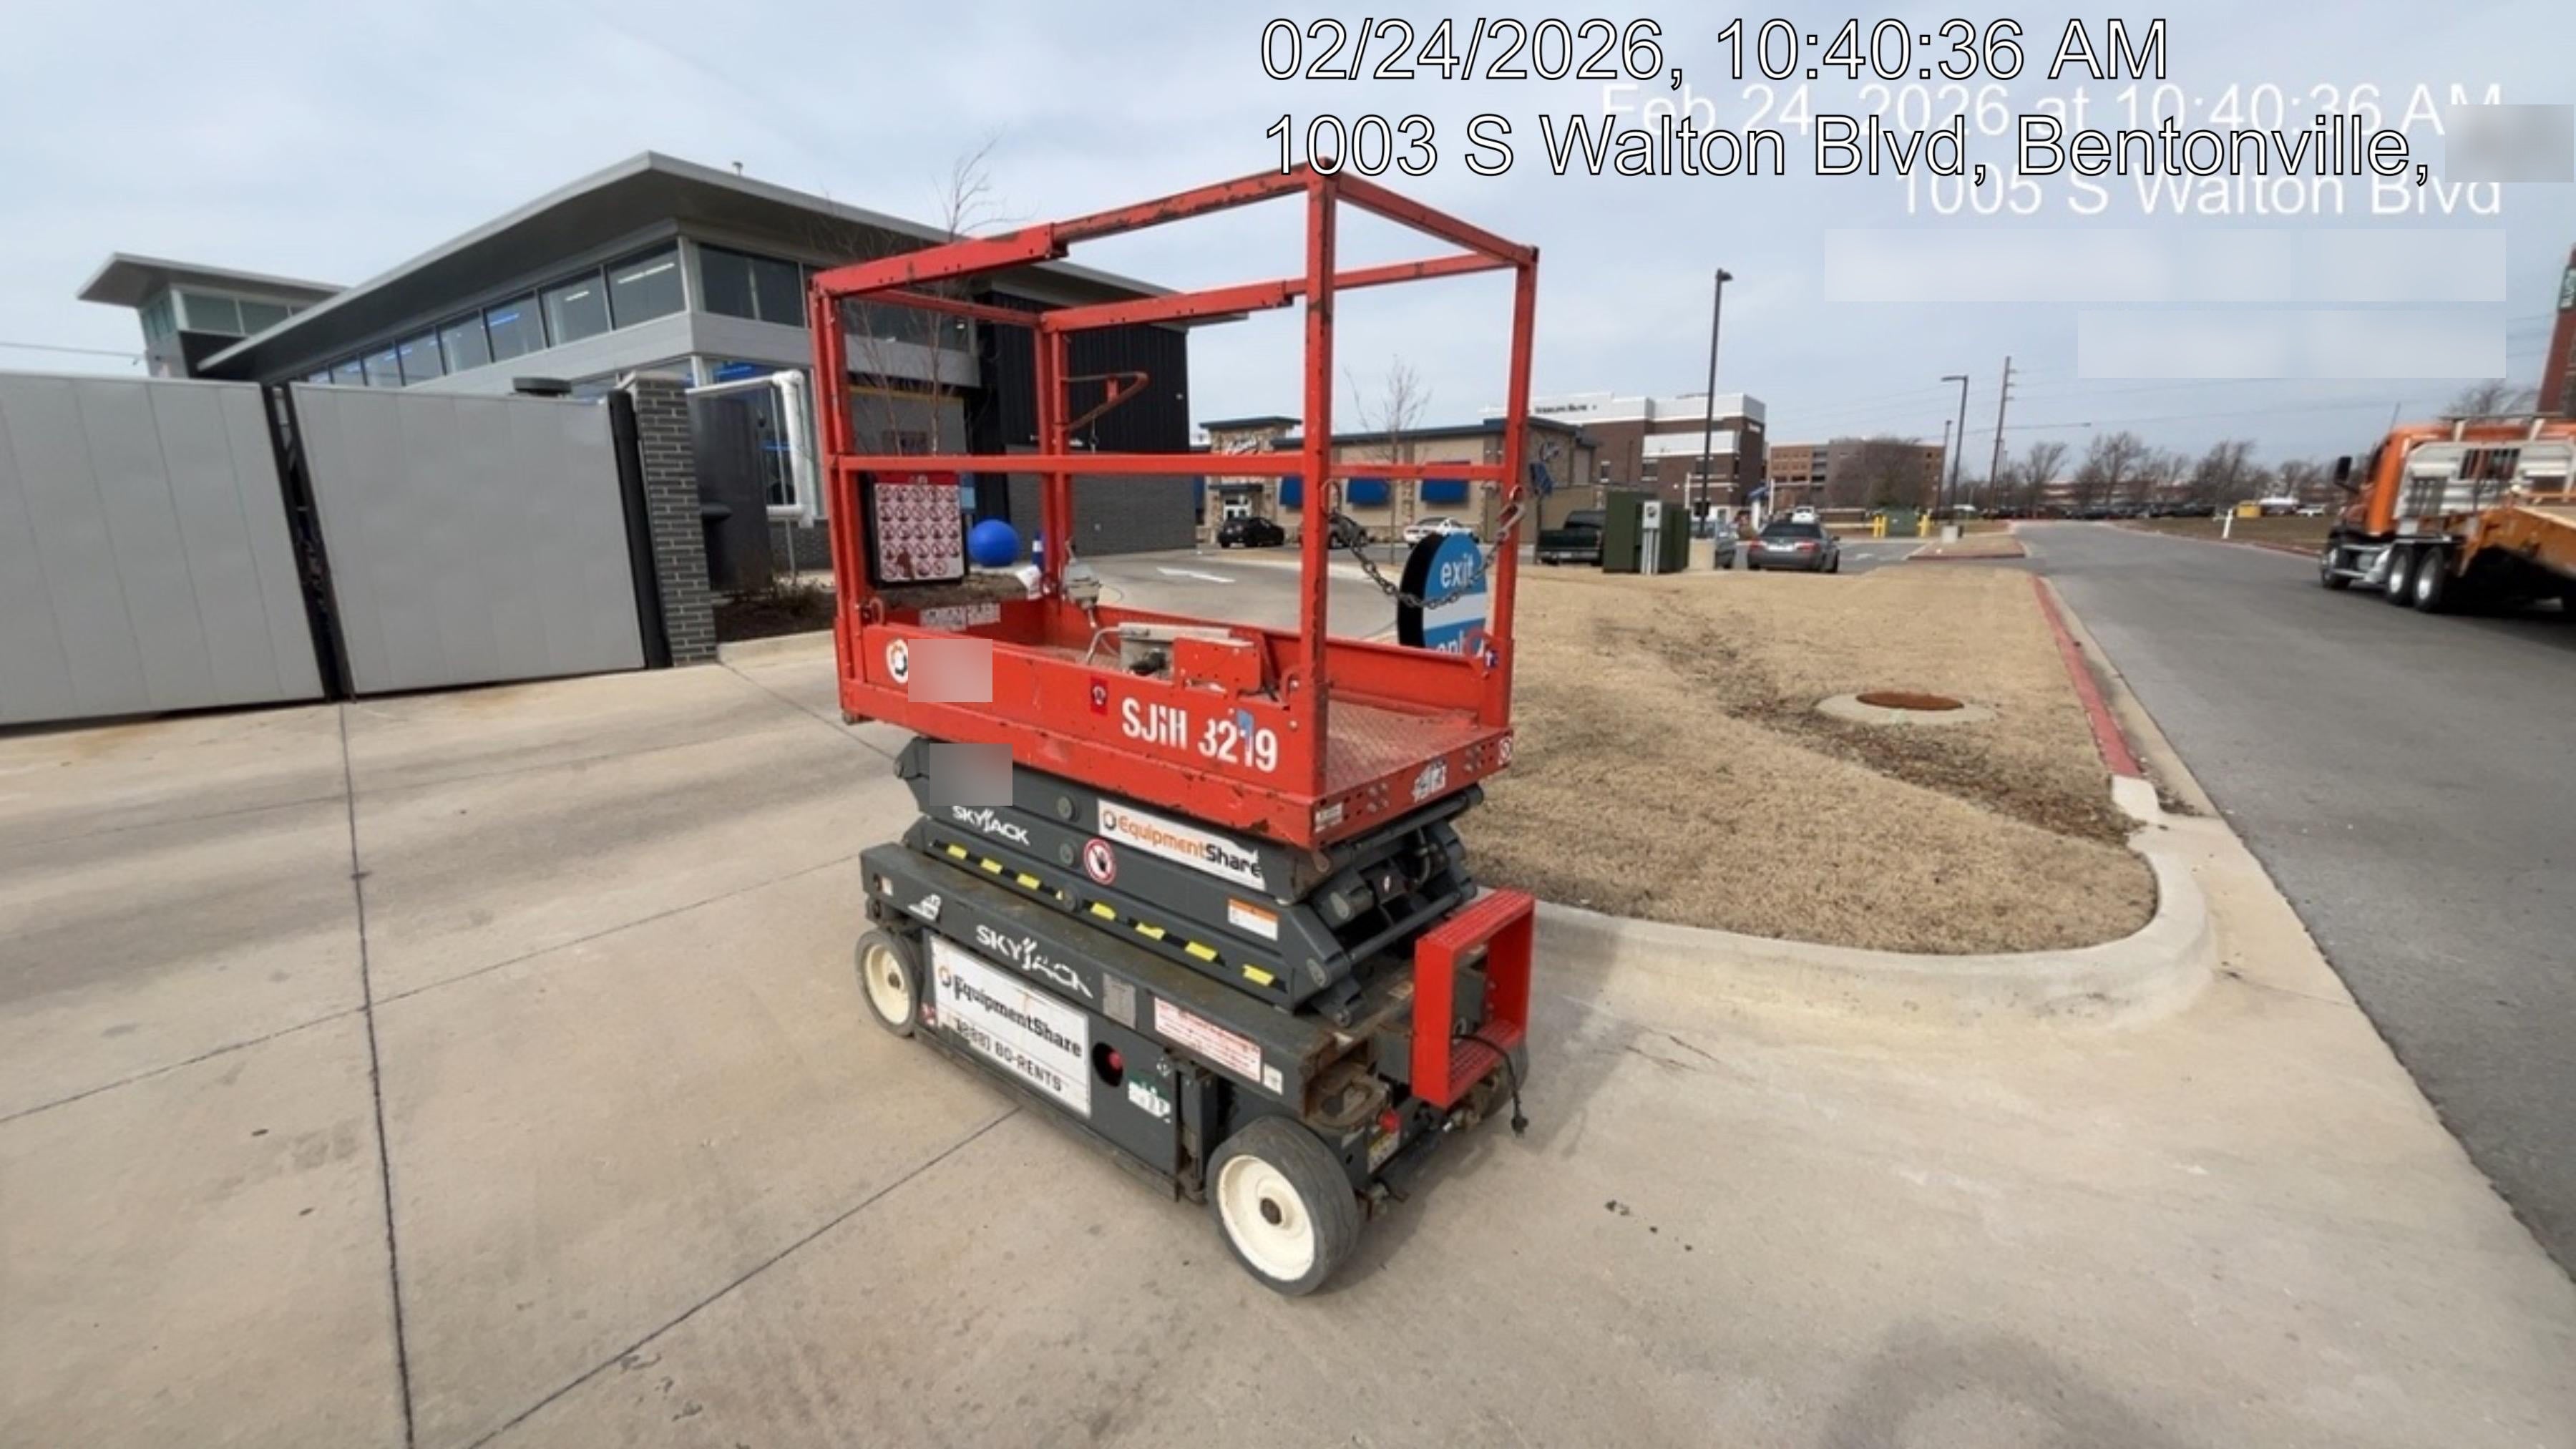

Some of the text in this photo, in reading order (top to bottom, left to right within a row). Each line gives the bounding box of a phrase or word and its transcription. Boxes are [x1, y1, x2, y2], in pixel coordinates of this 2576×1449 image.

[1440, 553, 1474, 589] exit
[1197, 717, 1279, 773] 3219
[952, 805, 1031, 847] SKYJACK
[1118, 814, 1262, 878] EquipmentShare
[953, 973, 1083, 1058] EquipmentShare
